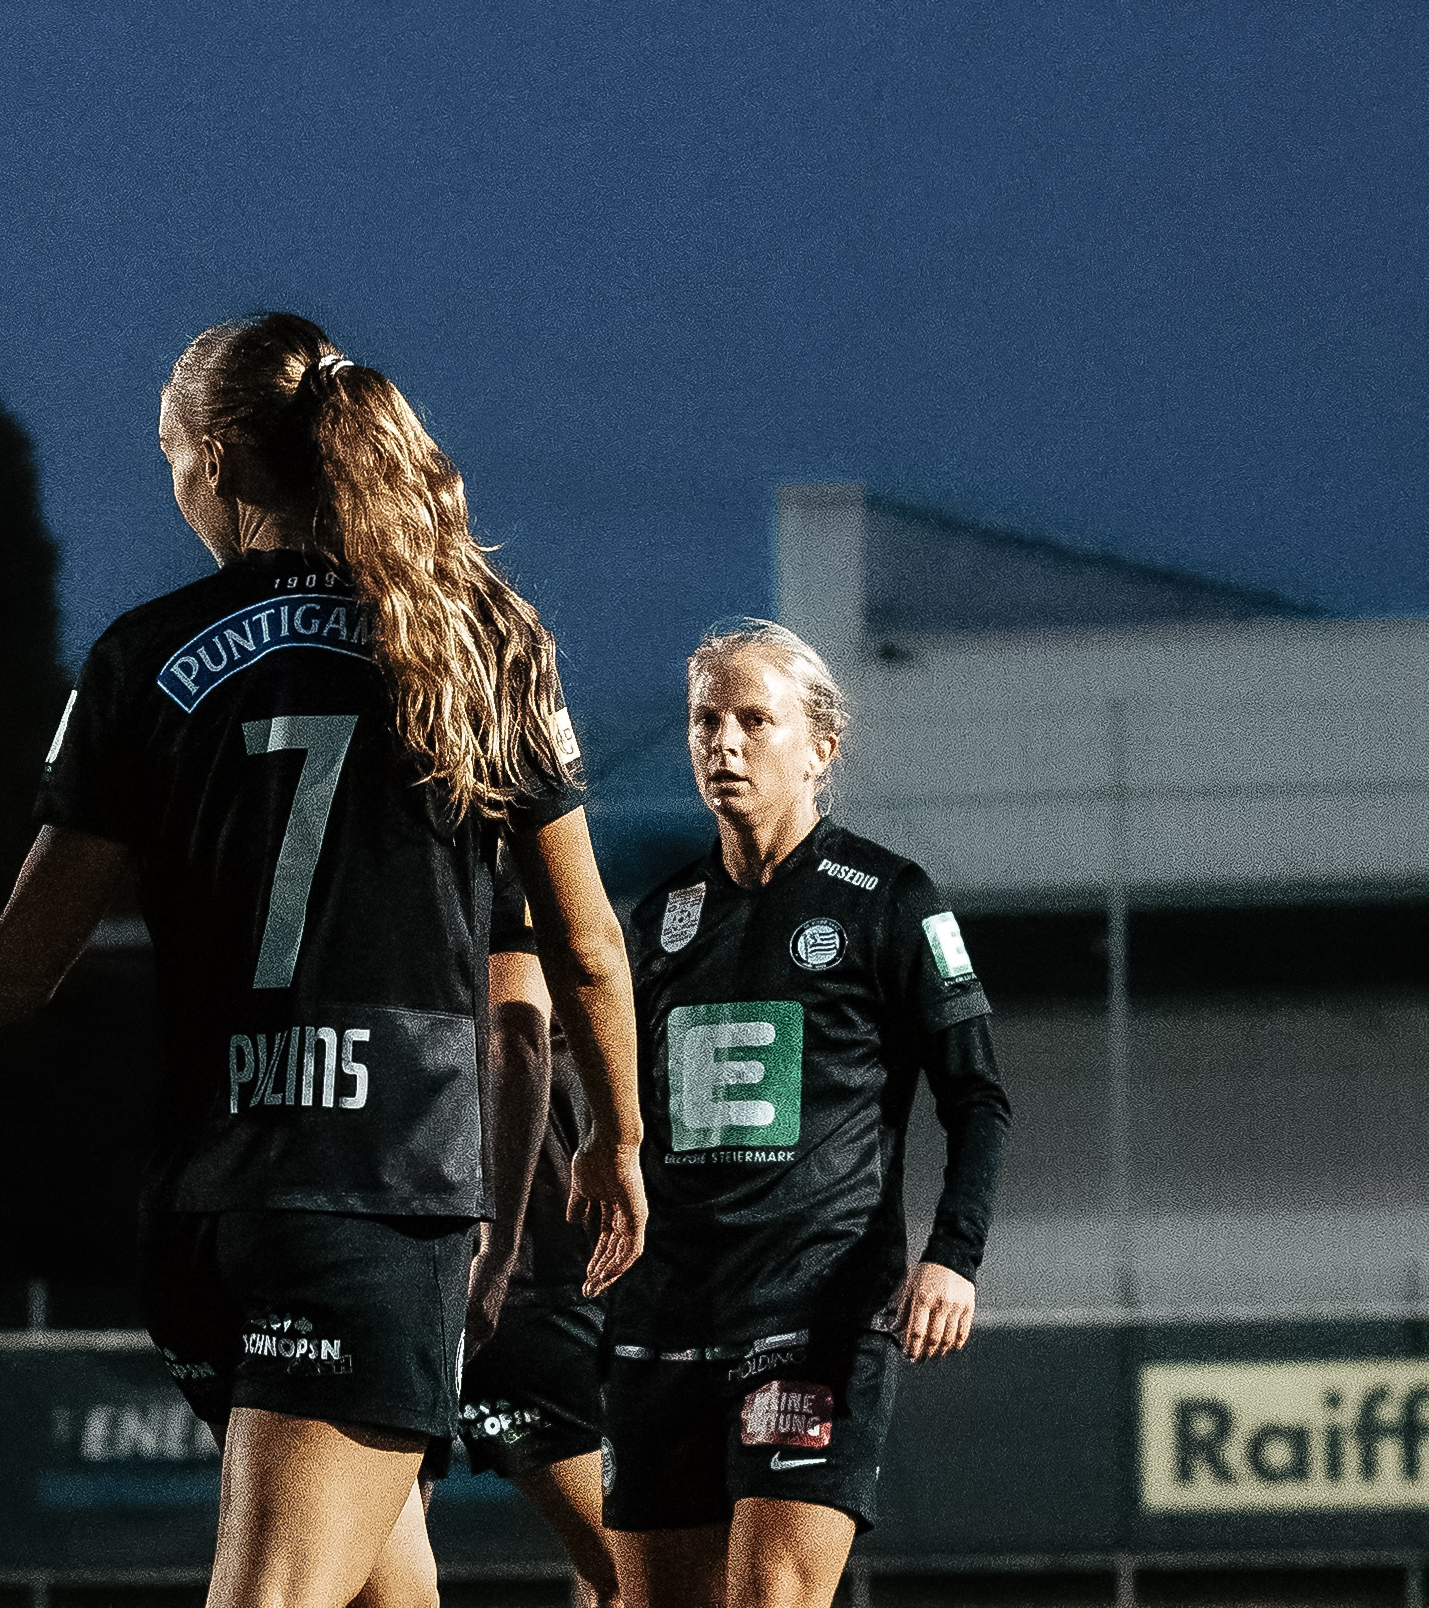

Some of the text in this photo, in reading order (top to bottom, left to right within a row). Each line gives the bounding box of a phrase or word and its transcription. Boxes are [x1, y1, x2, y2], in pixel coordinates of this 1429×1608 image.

[274, 571, 335, 589] 1909
[241, 714, 359, 990] 7
[817, 858, 879, 891] POSEDIO
[711, 1150, 796, 1164] STEIERMARK
[1172, 1382, 1429, 1486] Raiff
